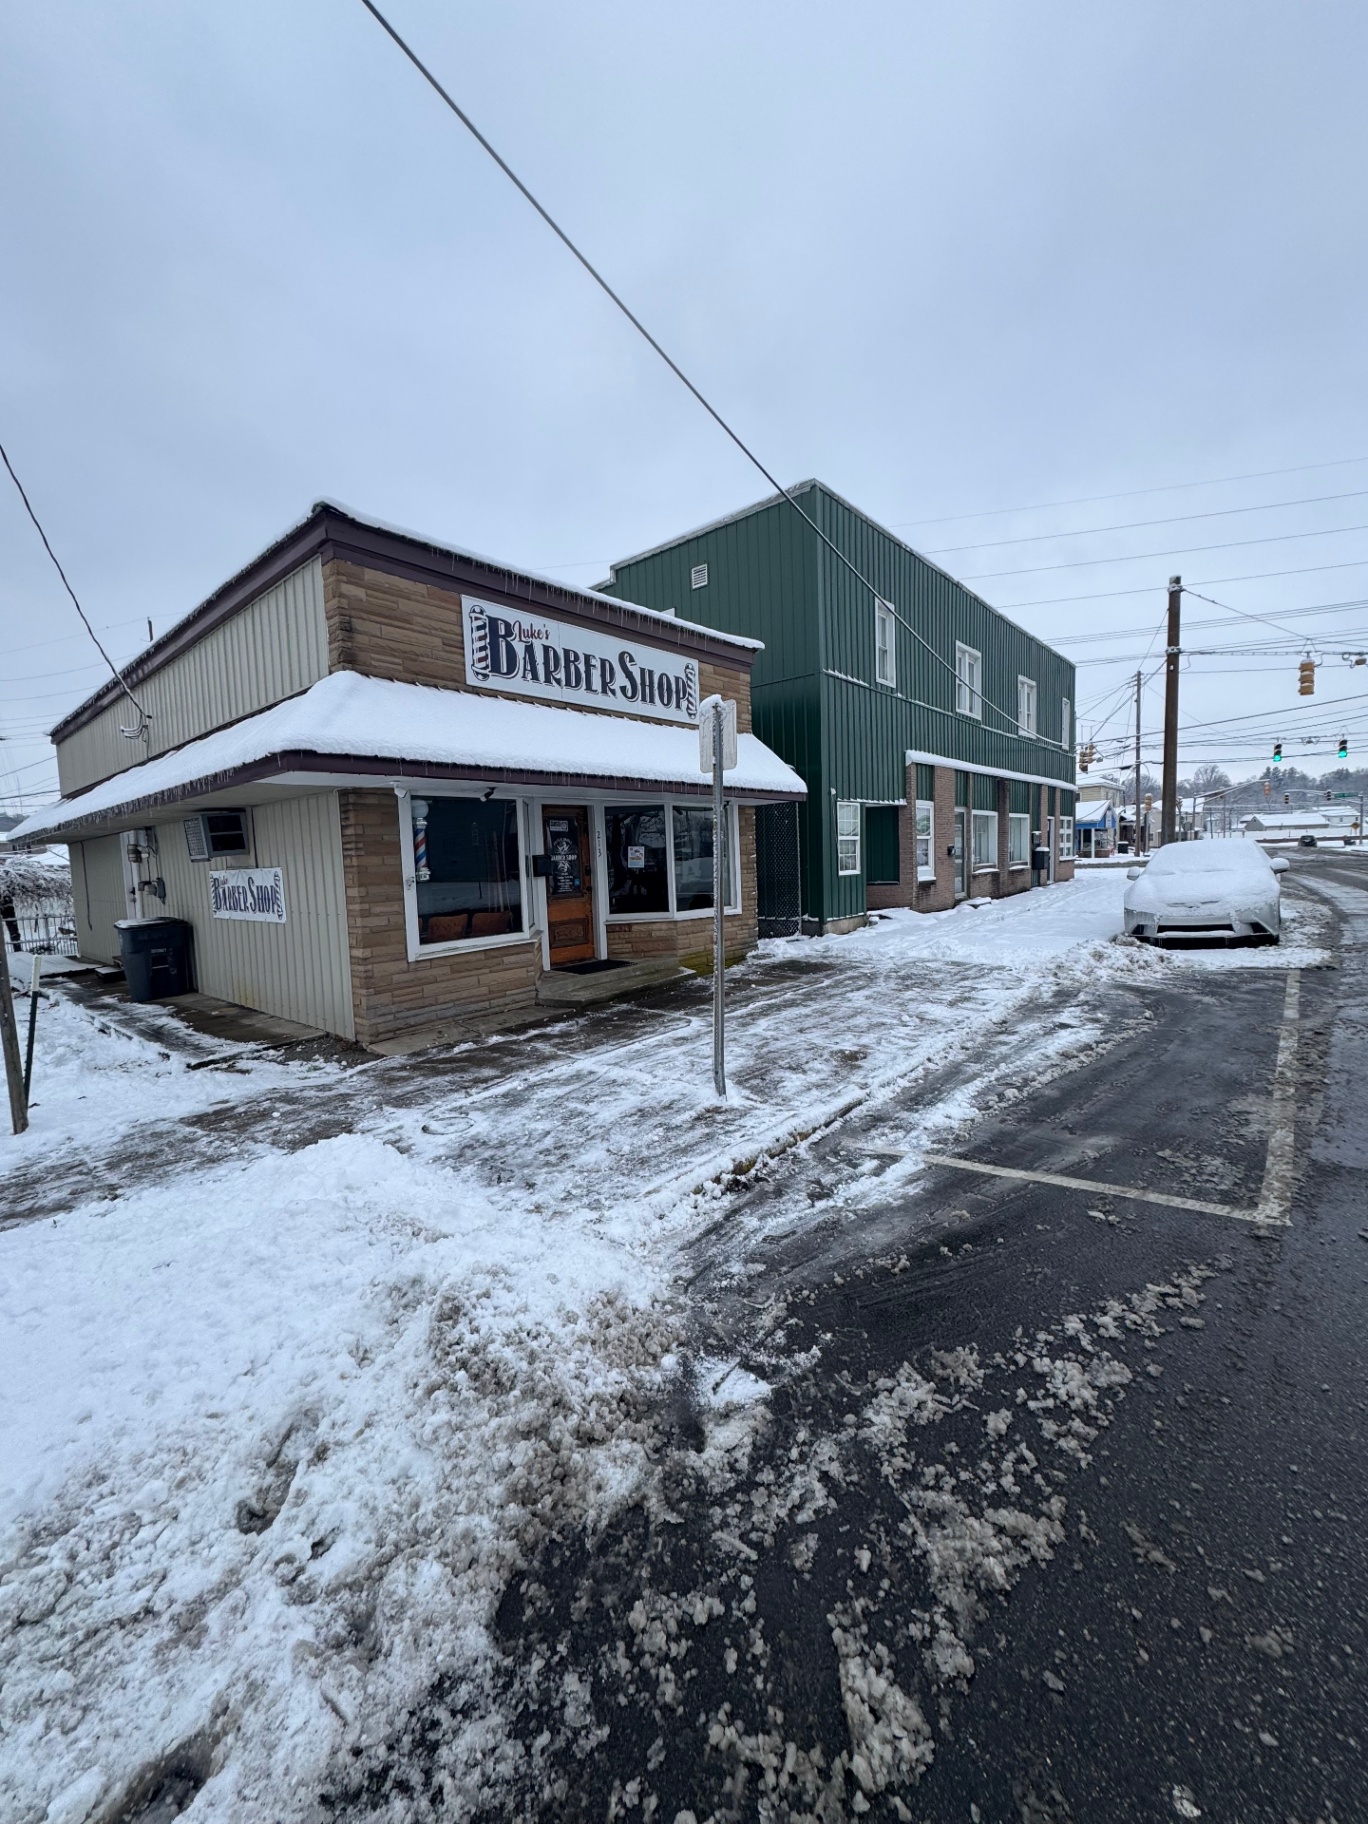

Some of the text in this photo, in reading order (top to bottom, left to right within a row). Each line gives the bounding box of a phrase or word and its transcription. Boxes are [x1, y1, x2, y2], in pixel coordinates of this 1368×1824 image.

[512, 620, 551, 642] Luke's
[487, 615, 689, 712] BARBER SHOP
[213, 876, 278, 914] BARBER SHOP
